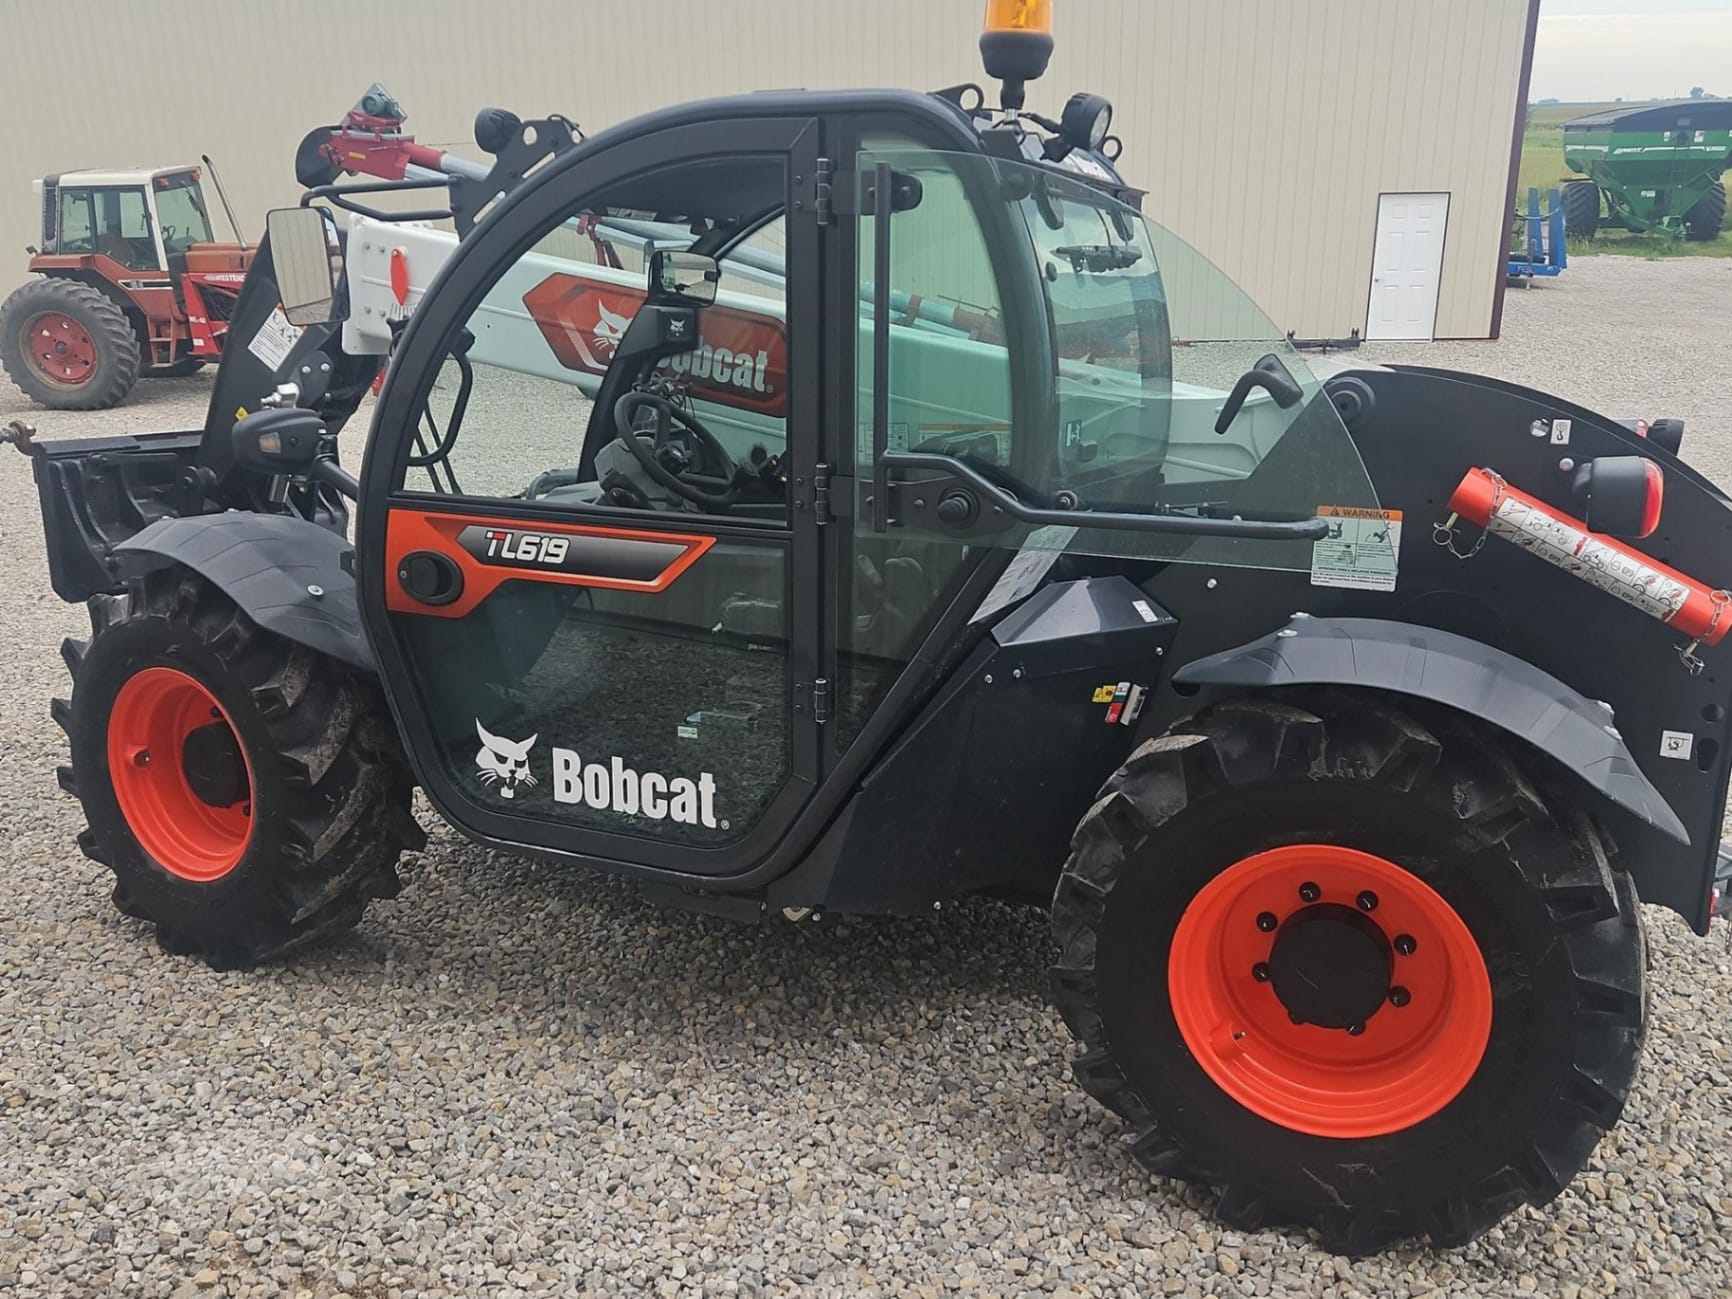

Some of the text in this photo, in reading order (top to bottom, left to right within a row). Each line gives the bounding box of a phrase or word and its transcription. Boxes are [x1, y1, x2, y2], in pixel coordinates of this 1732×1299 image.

[657, 344, 769, 392] obcat
[1343, 506, 1390, 519] WARNING
[486, 531, 570, 564] TL619
[552, 747, 717, 829] Bobcat
